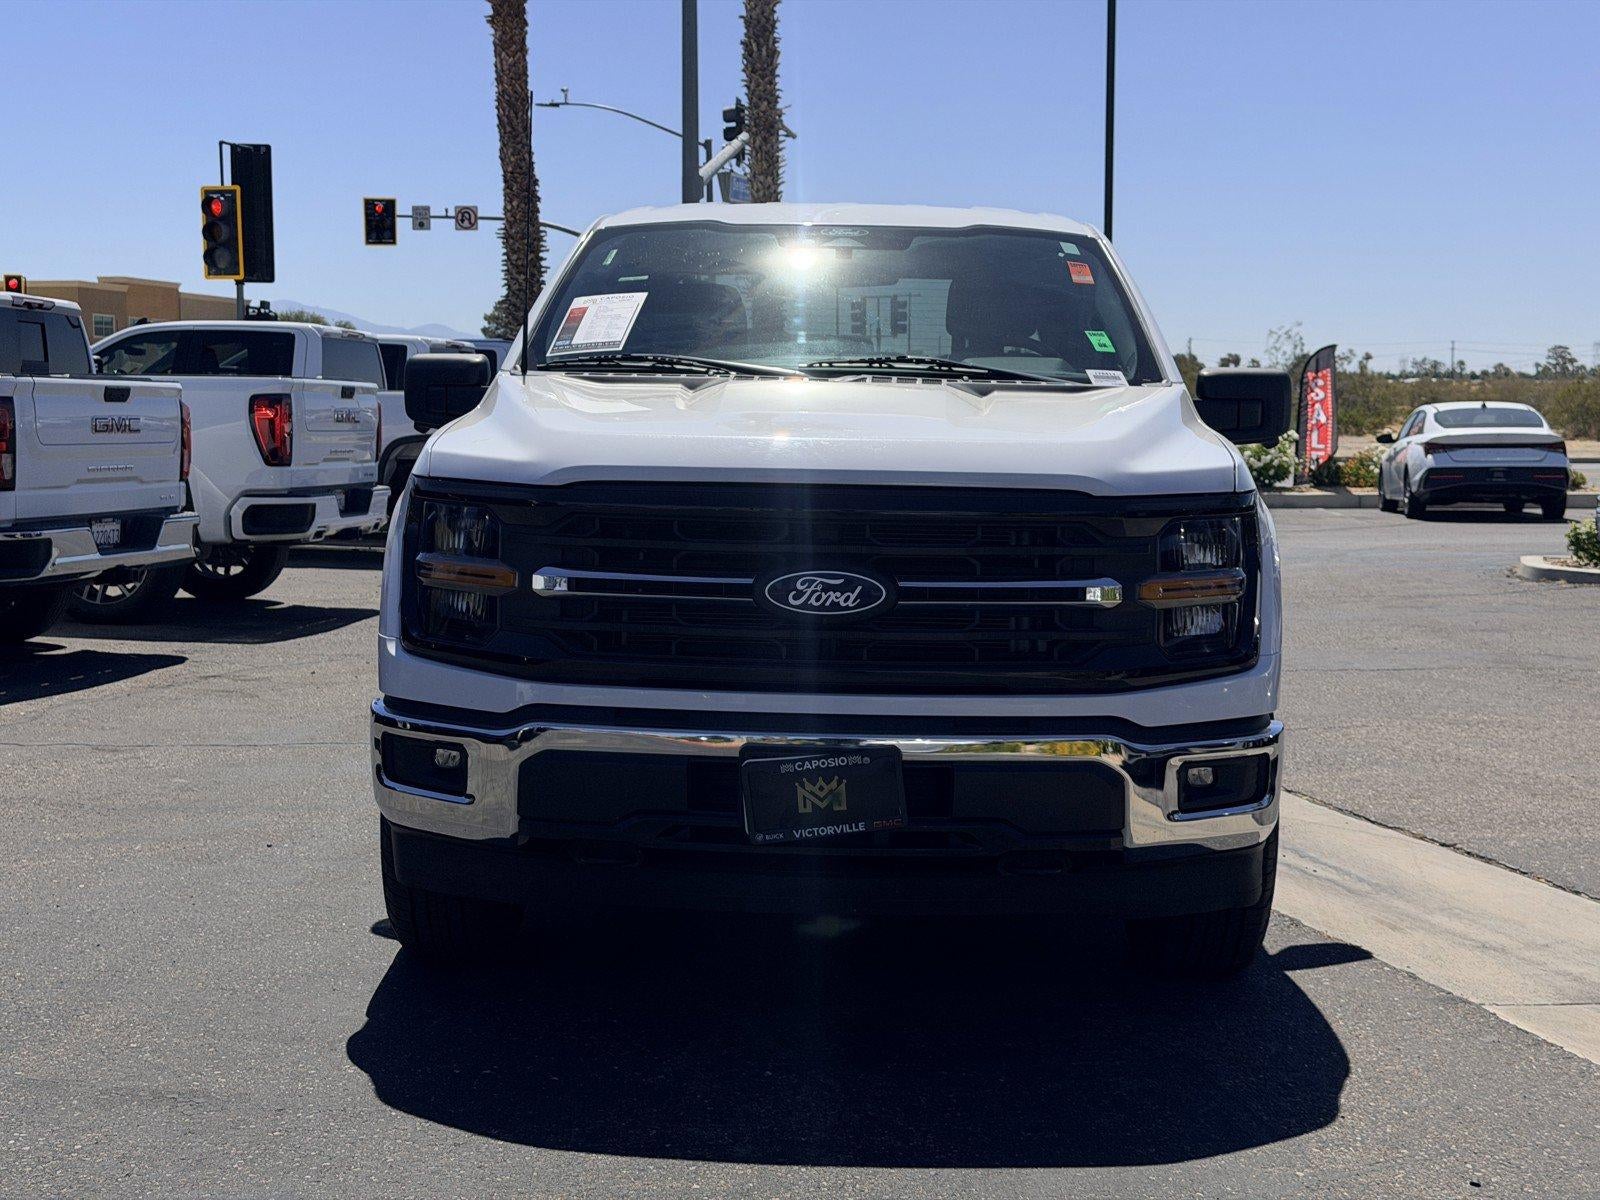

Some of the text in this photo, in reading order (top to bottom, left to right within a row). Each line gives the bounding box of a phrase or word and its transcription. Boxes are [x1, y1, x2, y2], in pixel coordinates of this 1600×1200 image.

[91, 416, 141, 434] GMC
[788, 576, 862, 607] Ford
[795, 756, 849, 771] CAPOSIO
[793, 822, 866, 839] VICTORVILLE
[873, 818, 902, 828] GMC
[765, 832, 784, 840] BUICK
